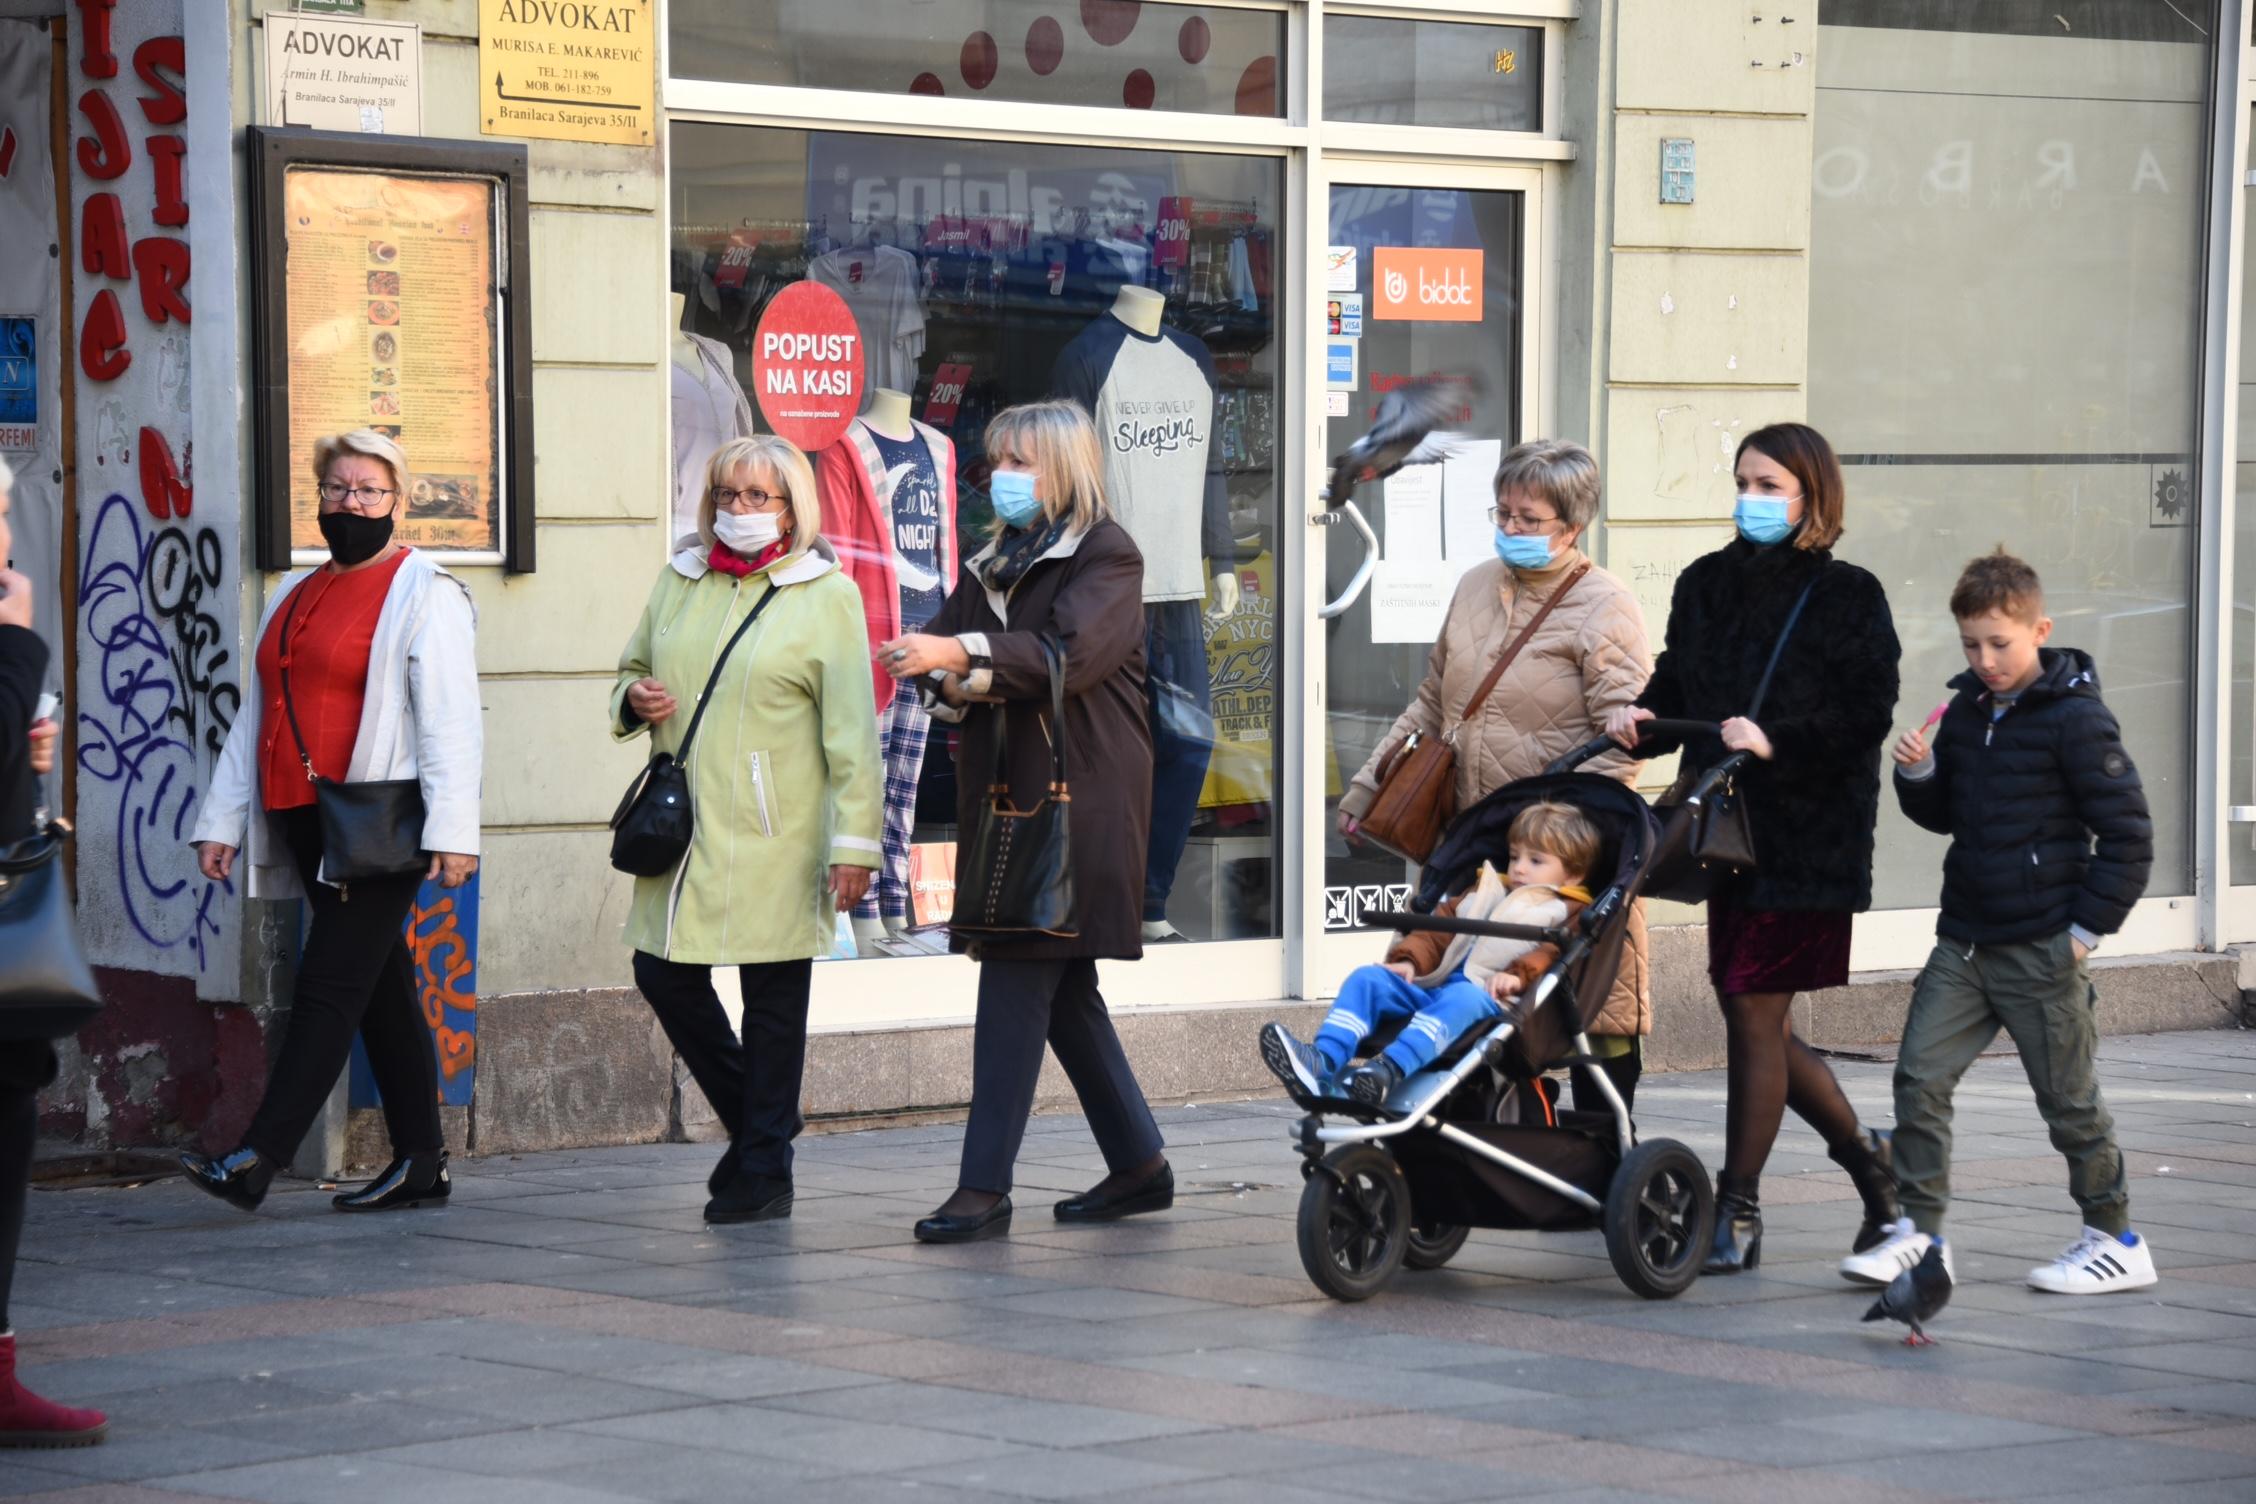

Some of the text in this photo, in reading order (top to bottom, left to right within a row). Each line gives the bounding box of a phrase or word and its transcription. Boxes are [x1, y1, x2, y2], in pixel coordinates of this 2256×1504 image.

[497, 0, 636, 33] ADVOKAT
[283, 30, 404, 61] ADVOKAT
[492, 38, 544, 54] MURISA
[563, 44, 643, 62] MAKAREVIĆ
[280, 67, 409, 88] Armin H. Ibrahimpašić
[537, 66, 600, 81] TEL. 211-896
[295, 91, 336, 104] Branilaca
[338, 95, 376, 107] Sarajeva
[525, 80, 612, 96] MOB. 061-182-759
[499, 105, 637, 129] Branilaca Sarajeva 35/II
[937, 229, 970, 241] Jasmil
[1156, 218, 1190, 241] -30%
[1344, 304, 1360, 313] VISA
[1344, 321, 1360, 330] VISA
[763, 332, 856, 362] POPUST
[767, 368, 852, 396] NA KASI
[1115, 400, 1151, 415] NEVER
[1154, 400, 1181, 414] GIVE
[1113, 417, 1204, 458] Sleeping
[1228, 619, 1272, 643] NYC
[1220, 716, 1253, 731] TRACK
